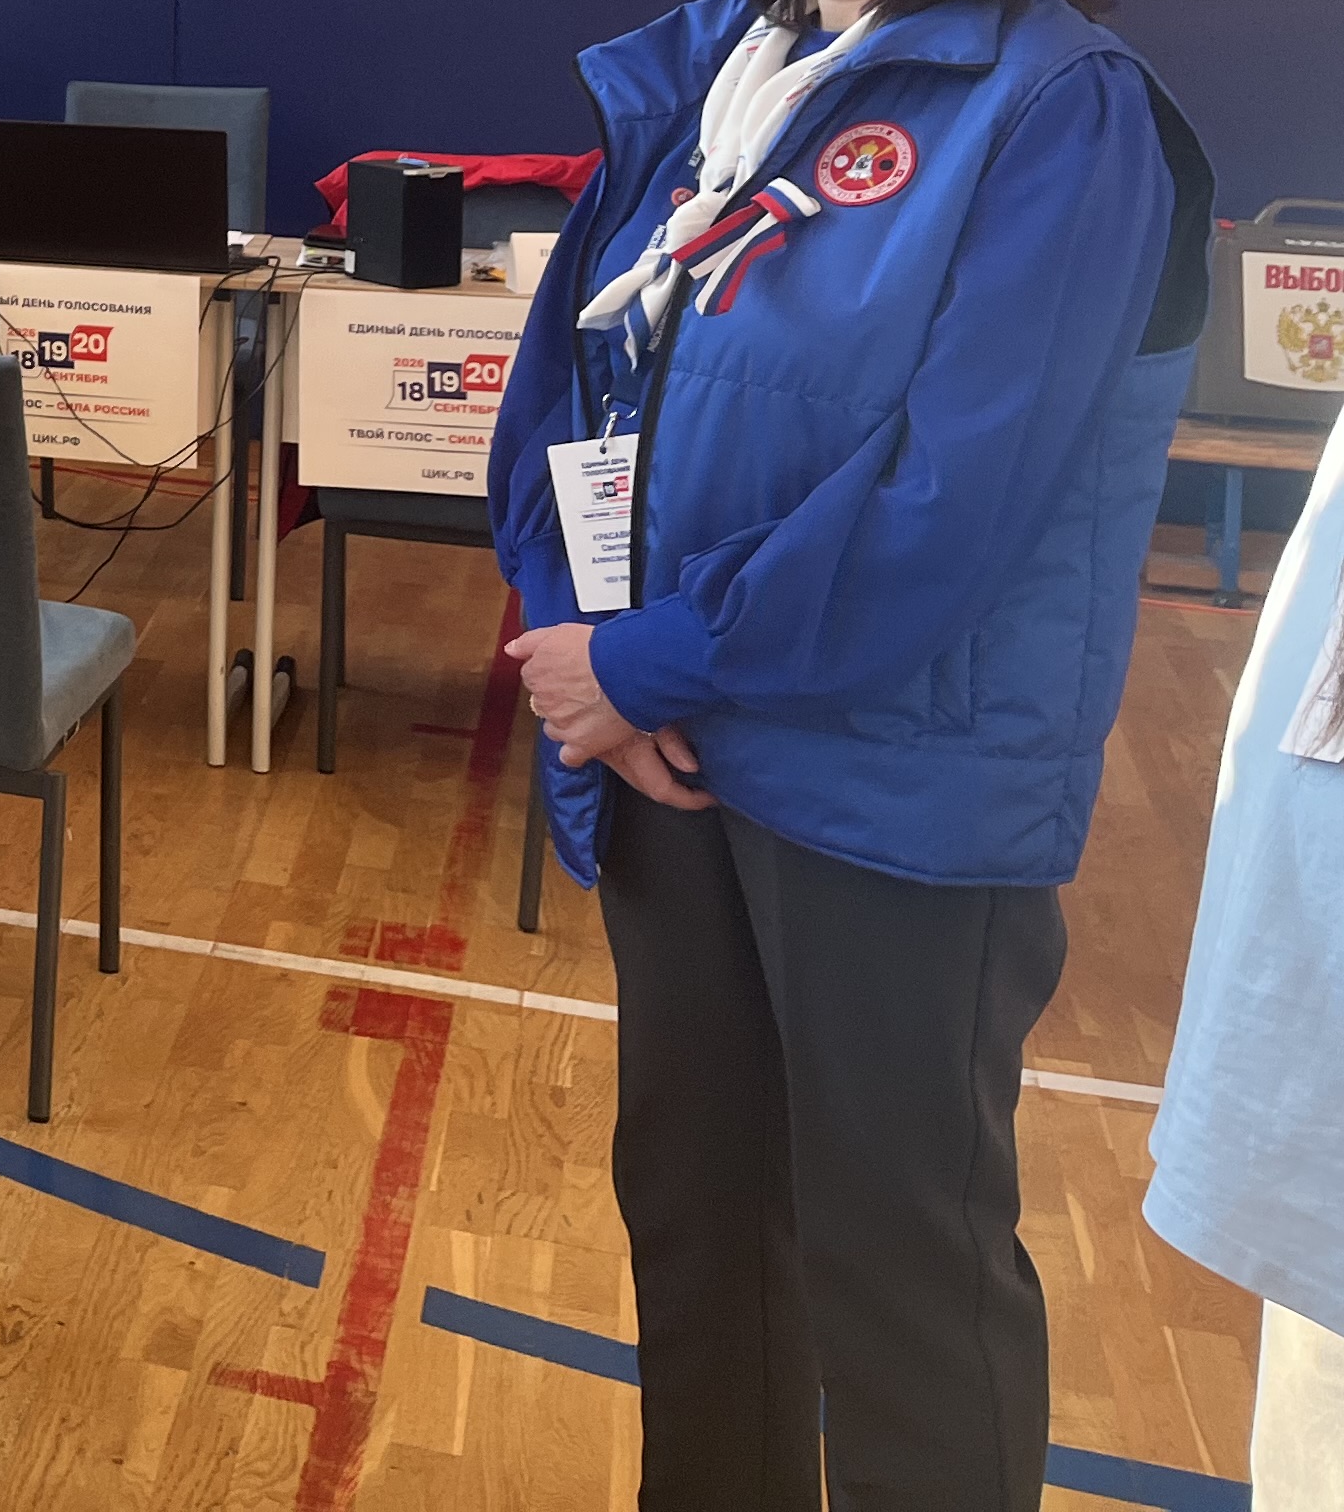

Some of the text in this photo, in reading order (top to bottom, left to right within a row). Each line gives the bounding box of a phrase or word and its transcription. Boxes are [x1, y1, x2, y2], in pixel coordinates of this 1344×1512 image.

[21, 297, 55, 308] ДЕНЬ
[57, 299, 152, 315] ГОЛОСОВАНИЯ
[348, 322, 406, 336] ЕДИНЫЙ
[408, 326, 445, 338] ДЕНЬ
[40, 339, 68, 362] 19
[72, 332, 106, 355] 20
[392, 357, 425, 368] 2026
[44, 371, 109, 385] СЕНТЯБРЯ
[430, 370, 460, 393] 19
[464, 361, 502, 385] 20
[396, 381, 425, 402] 18
[56, 401, 91, 413] СИЛА
[93, 404, 151, 418] РОССИИ!
[31, 432, 82, 446] ЦИК.РФ
[348, 428, 385, 439] ТВОЙ
[387, 430, 433, 443] ГОЛОС
[448, 433, 486, 446] СИЛА
